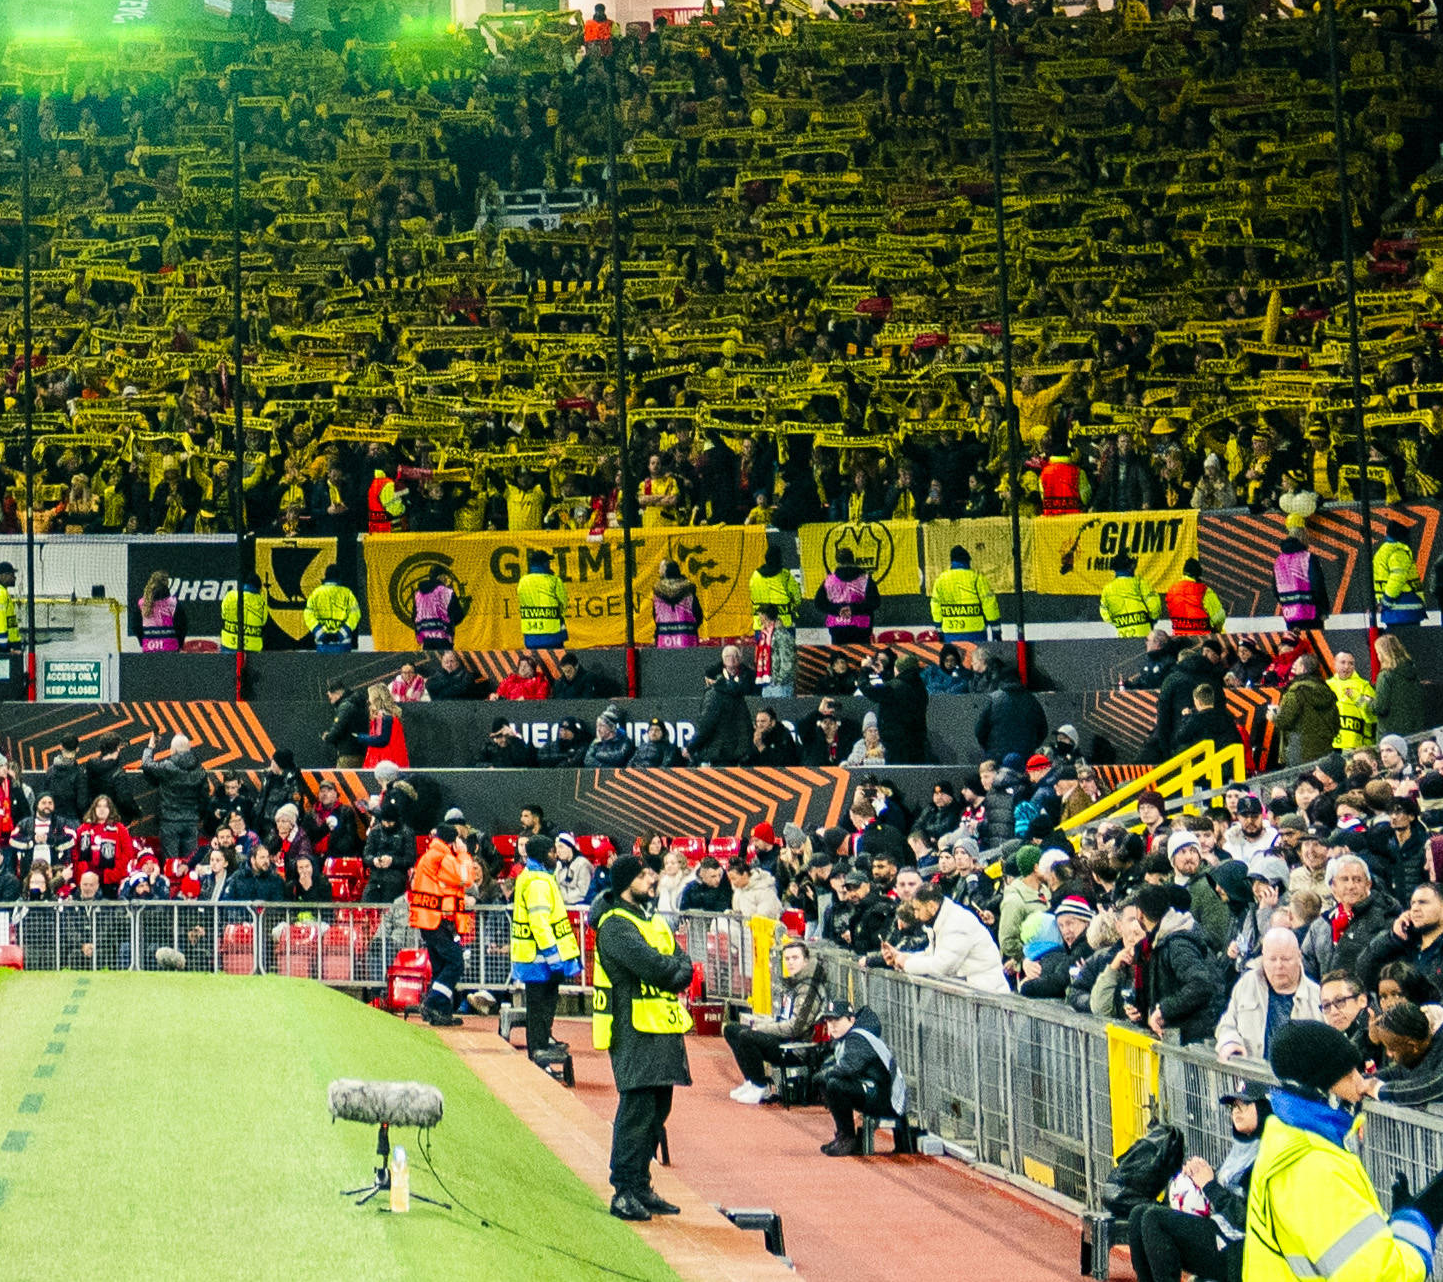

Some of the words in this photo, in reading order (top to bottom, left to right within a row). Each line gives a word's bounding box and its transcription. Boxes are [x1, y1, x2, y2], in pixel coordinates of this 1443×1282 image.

[1099, 518, 1184, 555] GLIMT
[489, 538, 647, 586] GIMT
[46, 673, 78, 682] ACCESS
[77, 672, 99, 682] ONLY
[45, 686, 68, 696] KEEP
[67, 685, 100, 696] CLOSED
